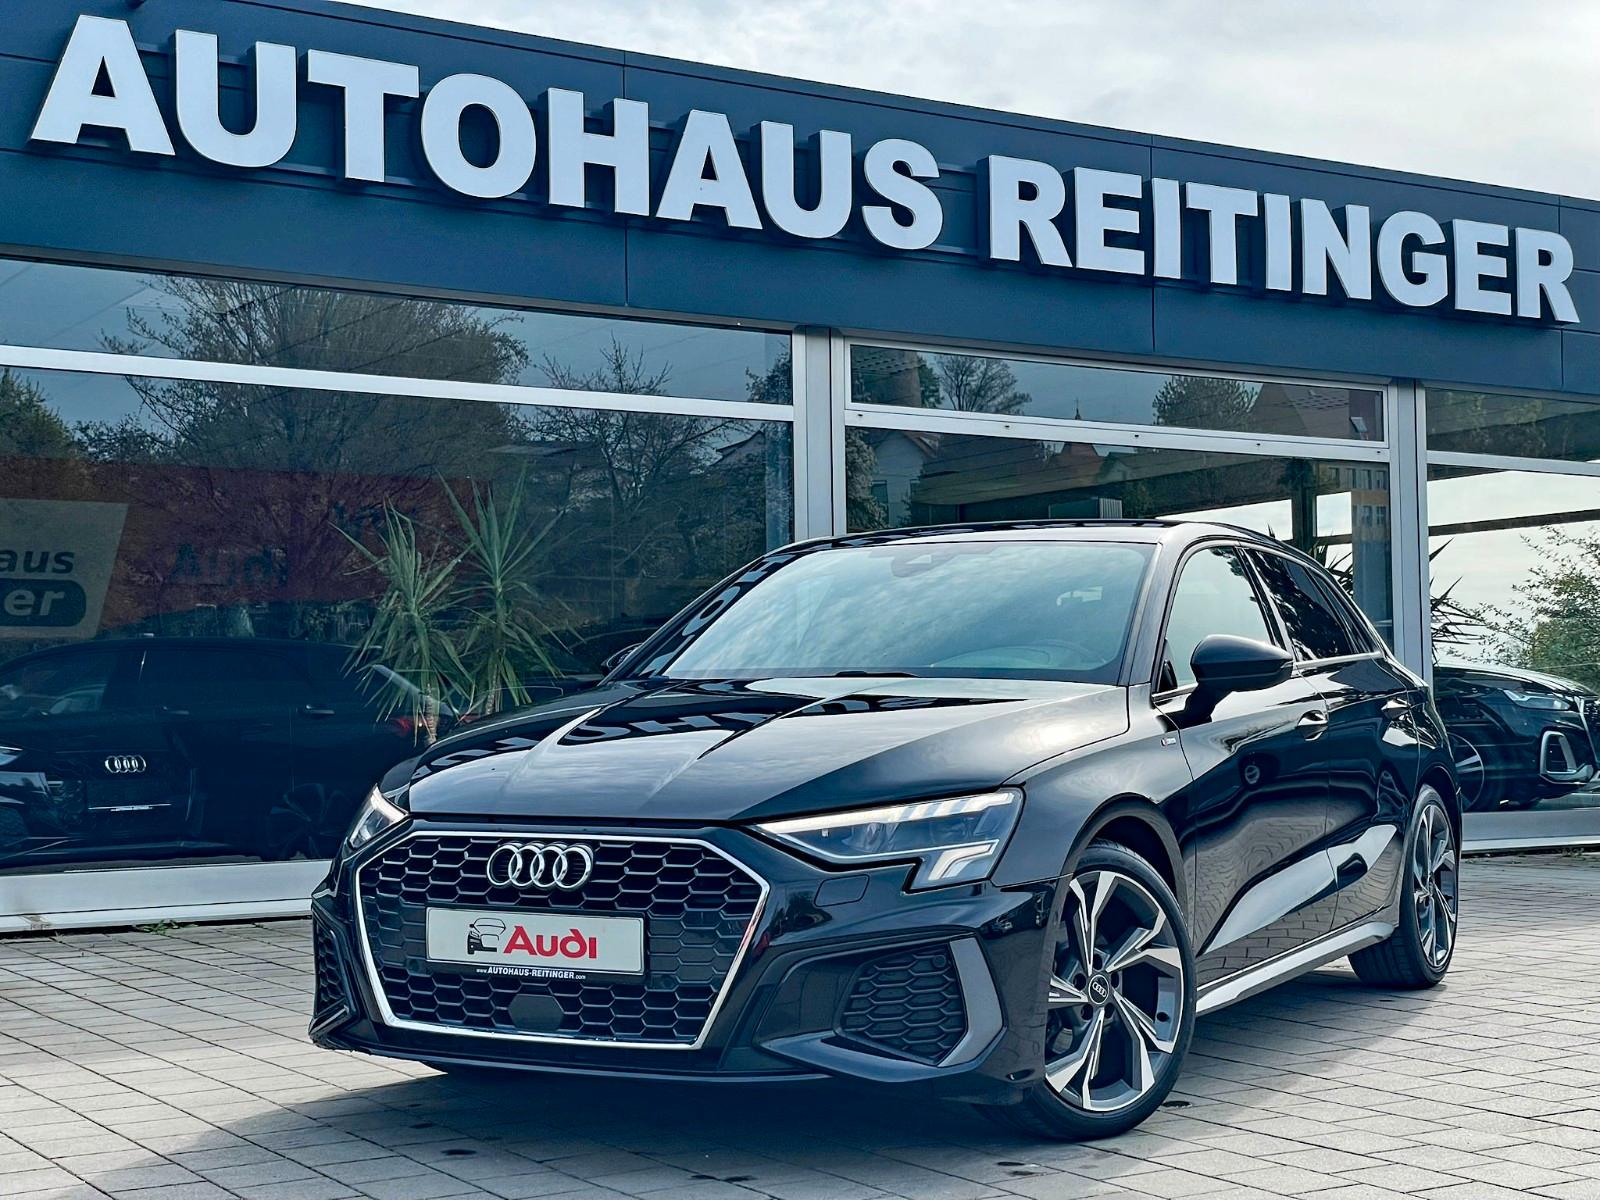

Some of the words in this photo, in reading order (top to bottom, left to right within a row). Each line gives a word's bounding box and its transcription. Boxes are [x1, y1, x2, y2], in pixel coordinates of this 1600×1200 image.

[31, 15, 943, 250] AUTOHAUS
[988, 154, 1580, 323] REITINGER
[0, 549, 75, 574] aus
[4, 589, 65, 616] er
[503, 925, 597, 959] Audi
